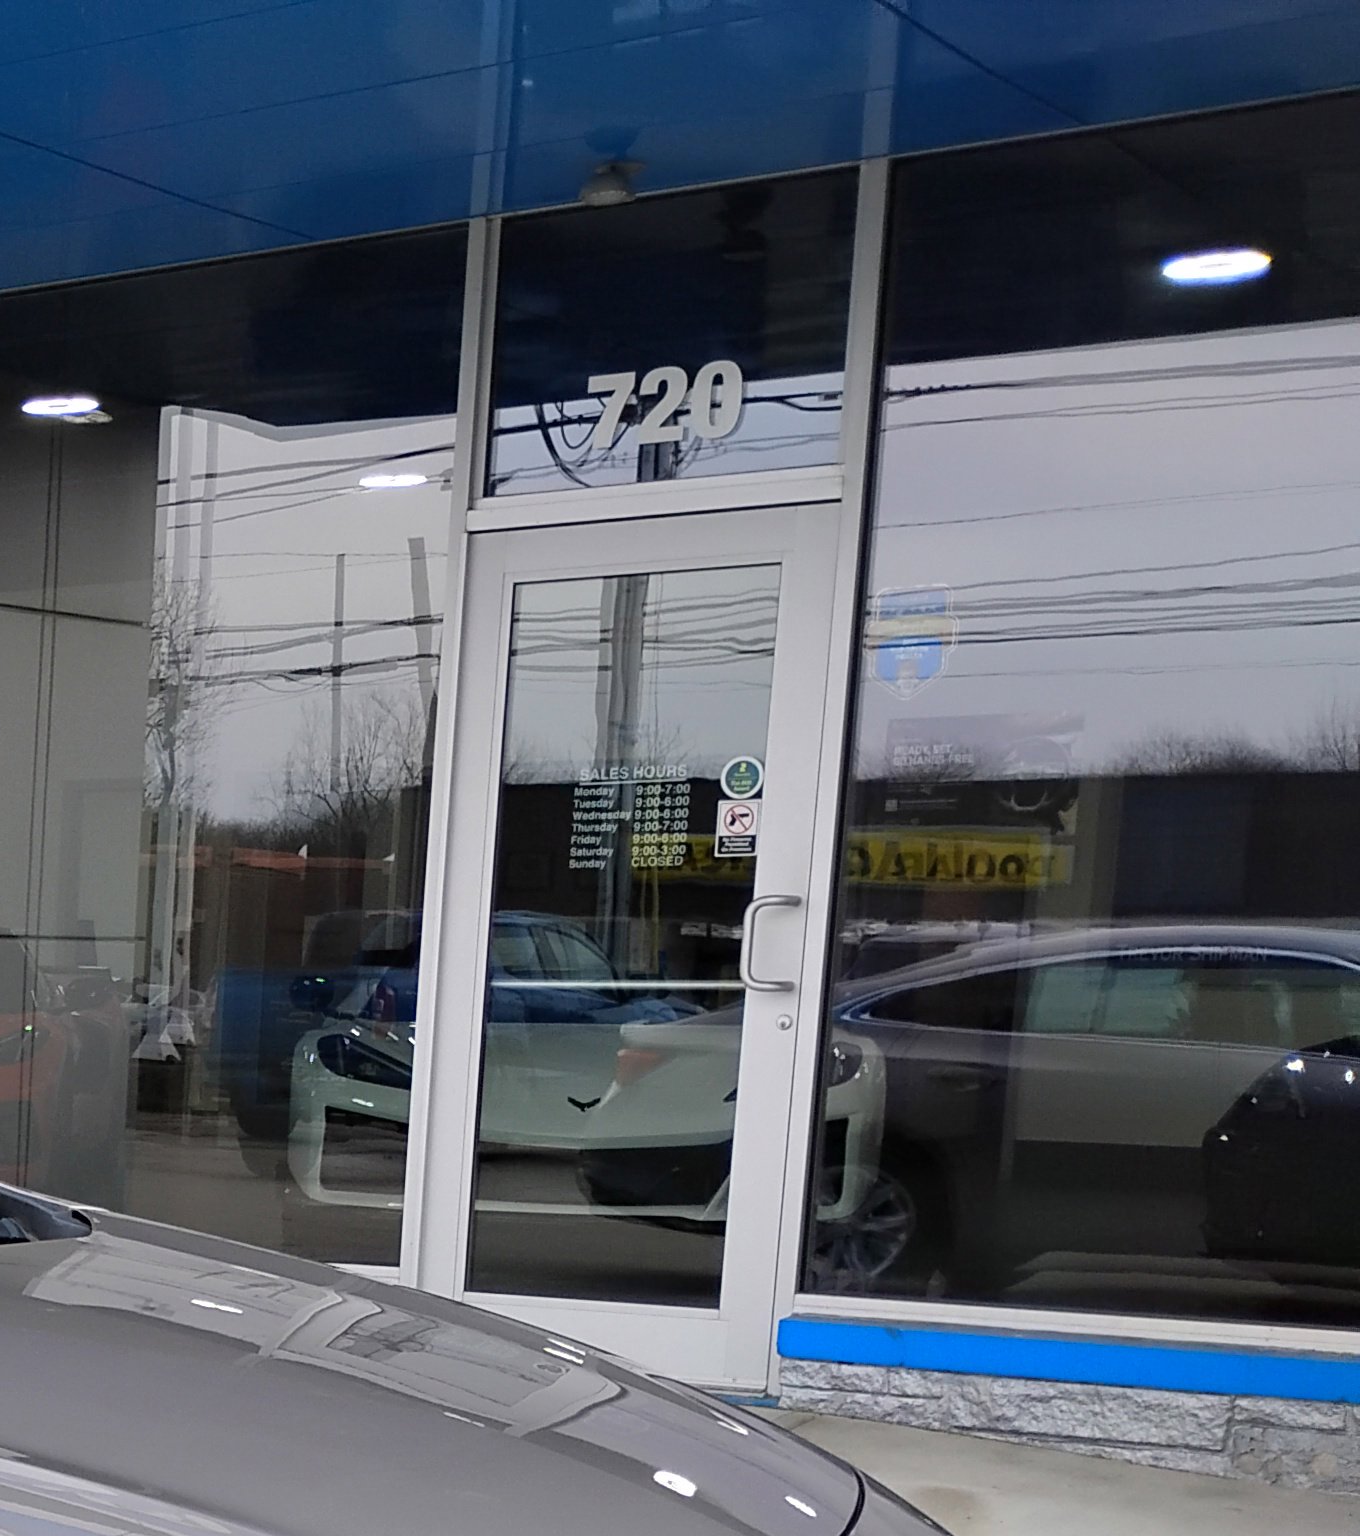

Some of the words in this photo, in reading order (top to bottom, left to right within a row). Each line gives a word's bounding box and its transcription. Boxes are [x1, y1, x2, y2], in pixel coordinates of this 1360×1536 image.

[587, 359, 743, 450] 720
[580, 766, 629, 781] SALES
[633, 764, 687, 779] HOURS
[574, 787, 614, 797] Monday
[636, 784, 690, 795] 9:00-7:00
[573, 799, 614, 809] Tuesday
[572, 811, 631, 820] Wednesday
[572, 823, 618, 833] Thursday
[633, 821, 688, 832] 9:00-7:00
[570, 835, 601, 845] Friday
[569, 847, 613, 857] Saturday
[568, 859, 606, 870] Sunday
[631, 856, 683, 867] CLOSED
